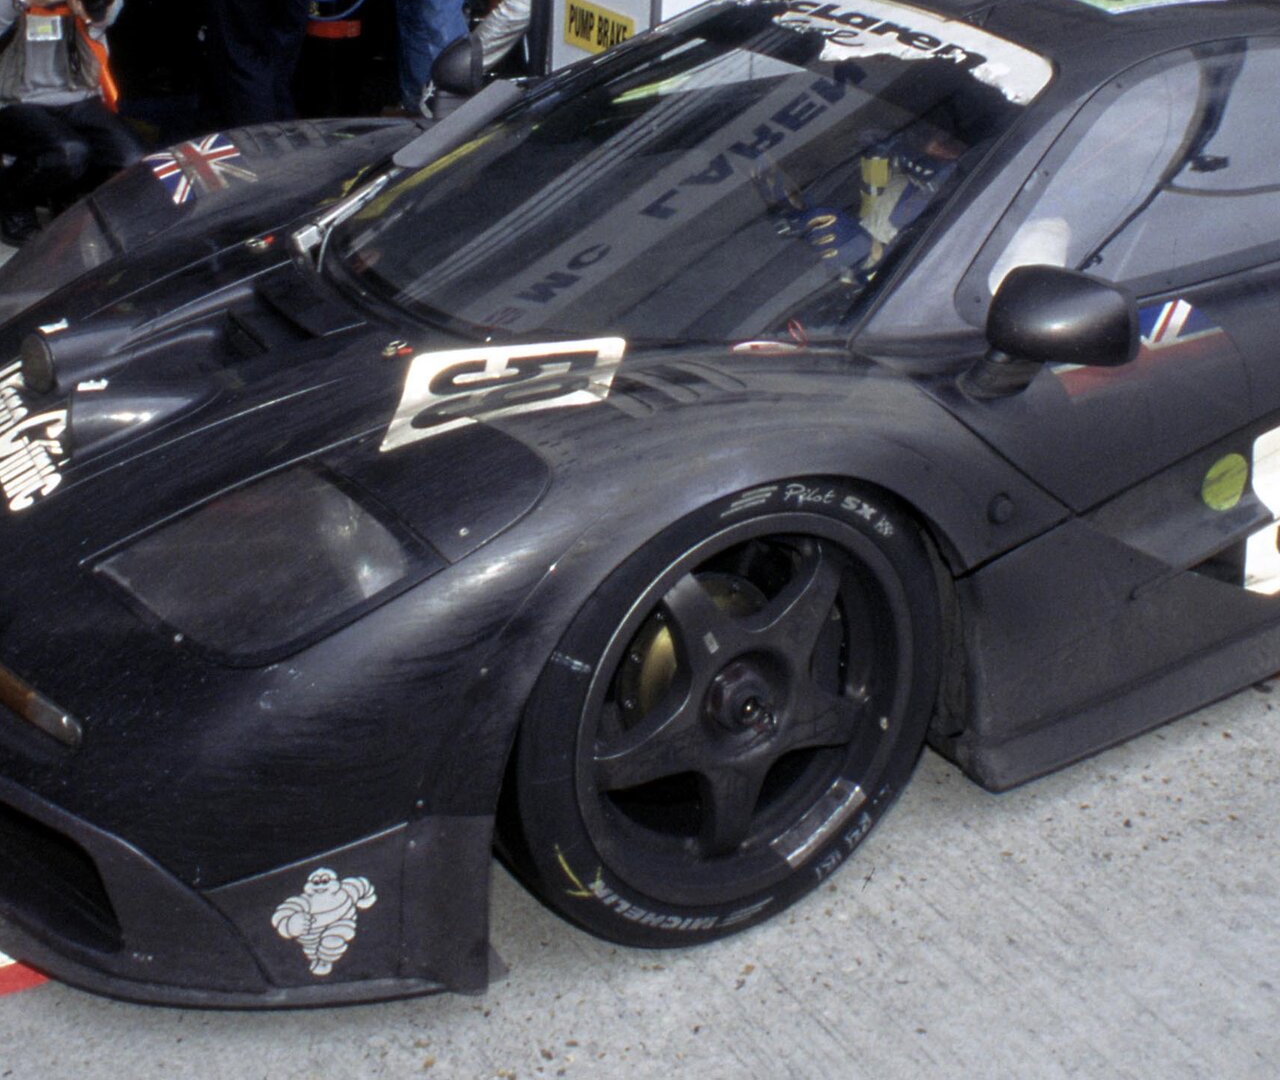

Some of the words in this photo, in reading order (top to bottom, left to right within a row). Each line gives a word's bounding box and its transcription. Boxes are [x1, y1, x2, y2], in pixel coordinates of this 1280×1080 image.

[569, 4, 595, 42] PUMP
[411, 350, 599, 429] 59
[783, 482, 836, 507] Pilot
[840, 495, 877, 521] SX
[588, 880, 719, 931] MICHELIN
